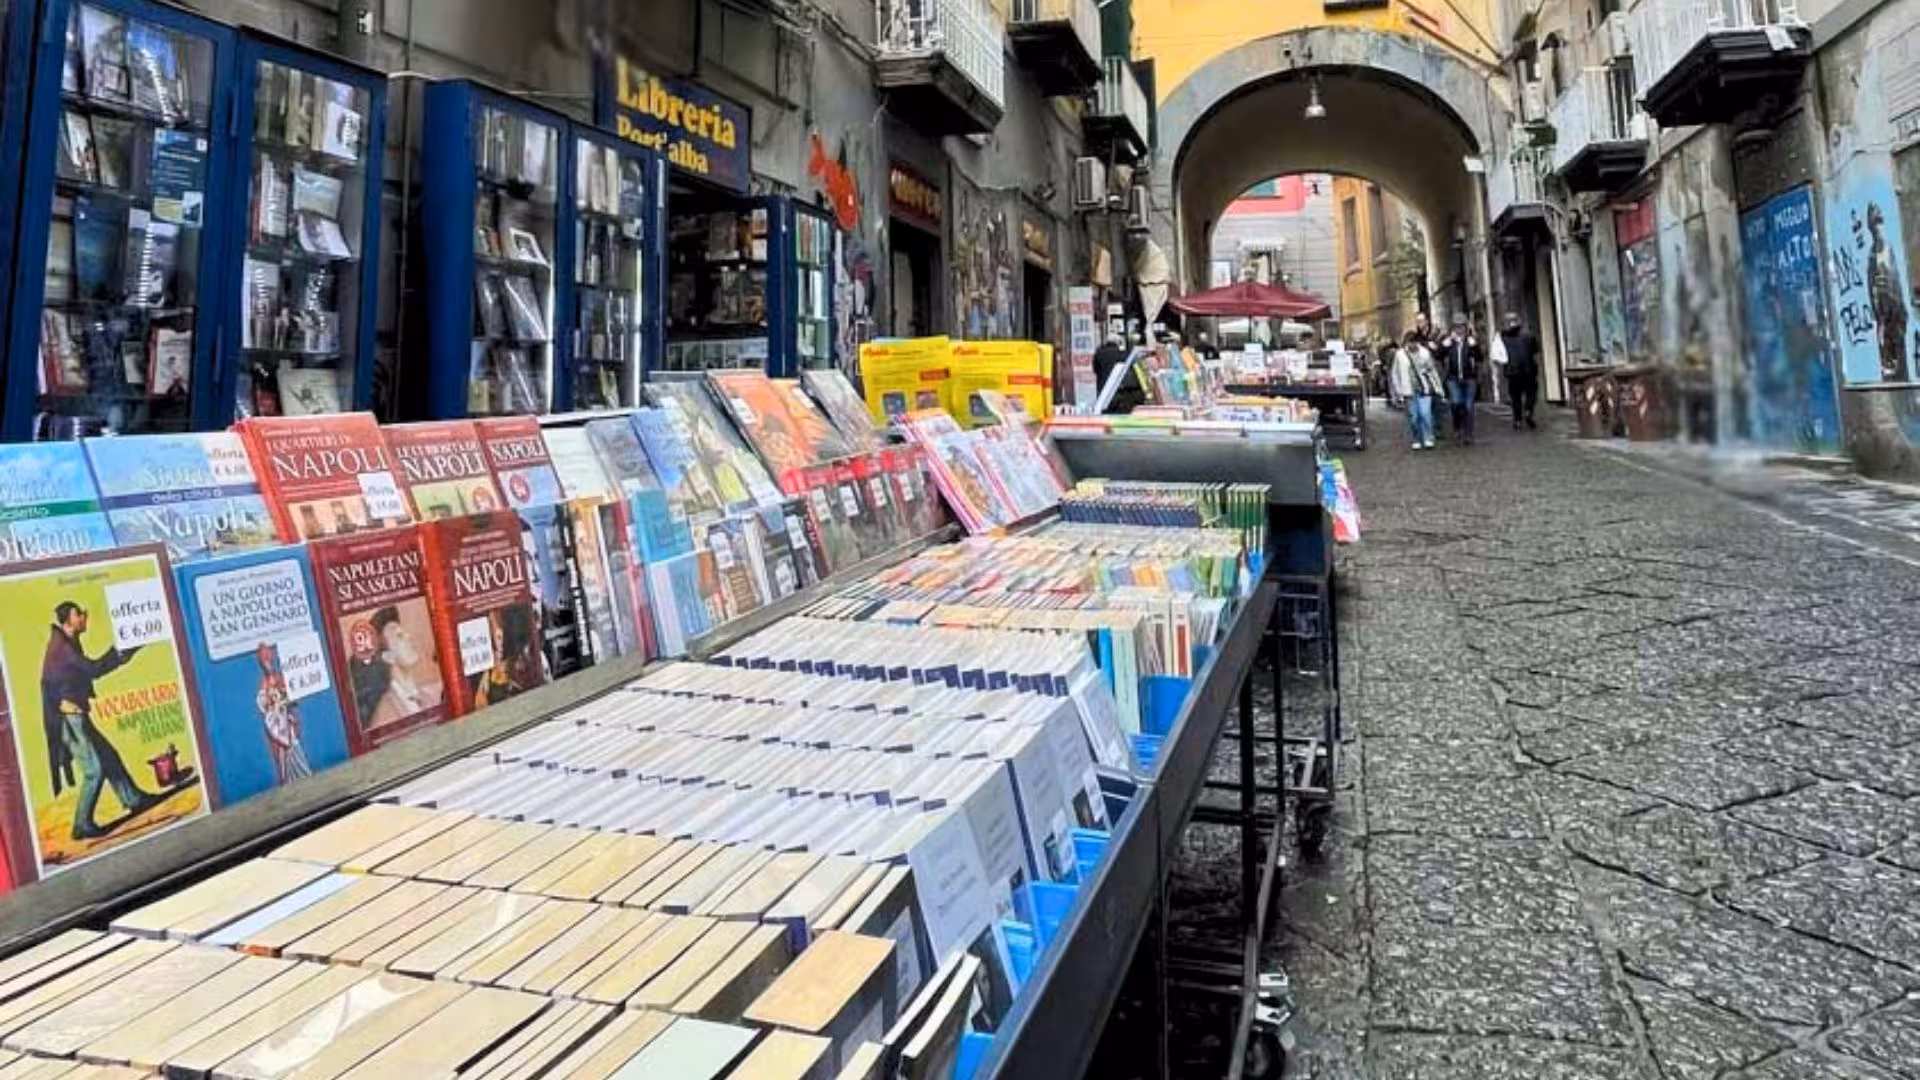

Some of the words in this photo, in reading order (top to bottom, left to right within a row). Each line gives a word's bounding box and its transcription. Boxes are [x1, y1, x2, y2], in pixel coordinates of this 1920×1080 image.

[617, 55, 736, 149] Libreria
[272, 446, 388, 482] NAPOLI
[488, 438, 546, 462] NAPOLI
[401, 451, 487, 482] NAPOLI
[145, 498, 258, 547] Napoli
[213, 588, 235, 607] UN
[238, 577, 295, 600] GIORNO
[355, 570, 419, 597] NASCEVA
[453, 555, 525, 597] NAPOLI
[111, 599, 162, 619] offerta
[208, 608, 219, 623] A
[224, 598, 272, 620] NAPOLI
[274, 590, 304, 608] CON
[210, 618, 239, 638] SAN
[242, 604, 309, 632] GENNARO
[119, 626, 130, 640] €
[132, 619, 163, 638] 6,00
[282, 652, 321, 673] offerta
[96, 682, 179, 720] VOCABOLARIO
